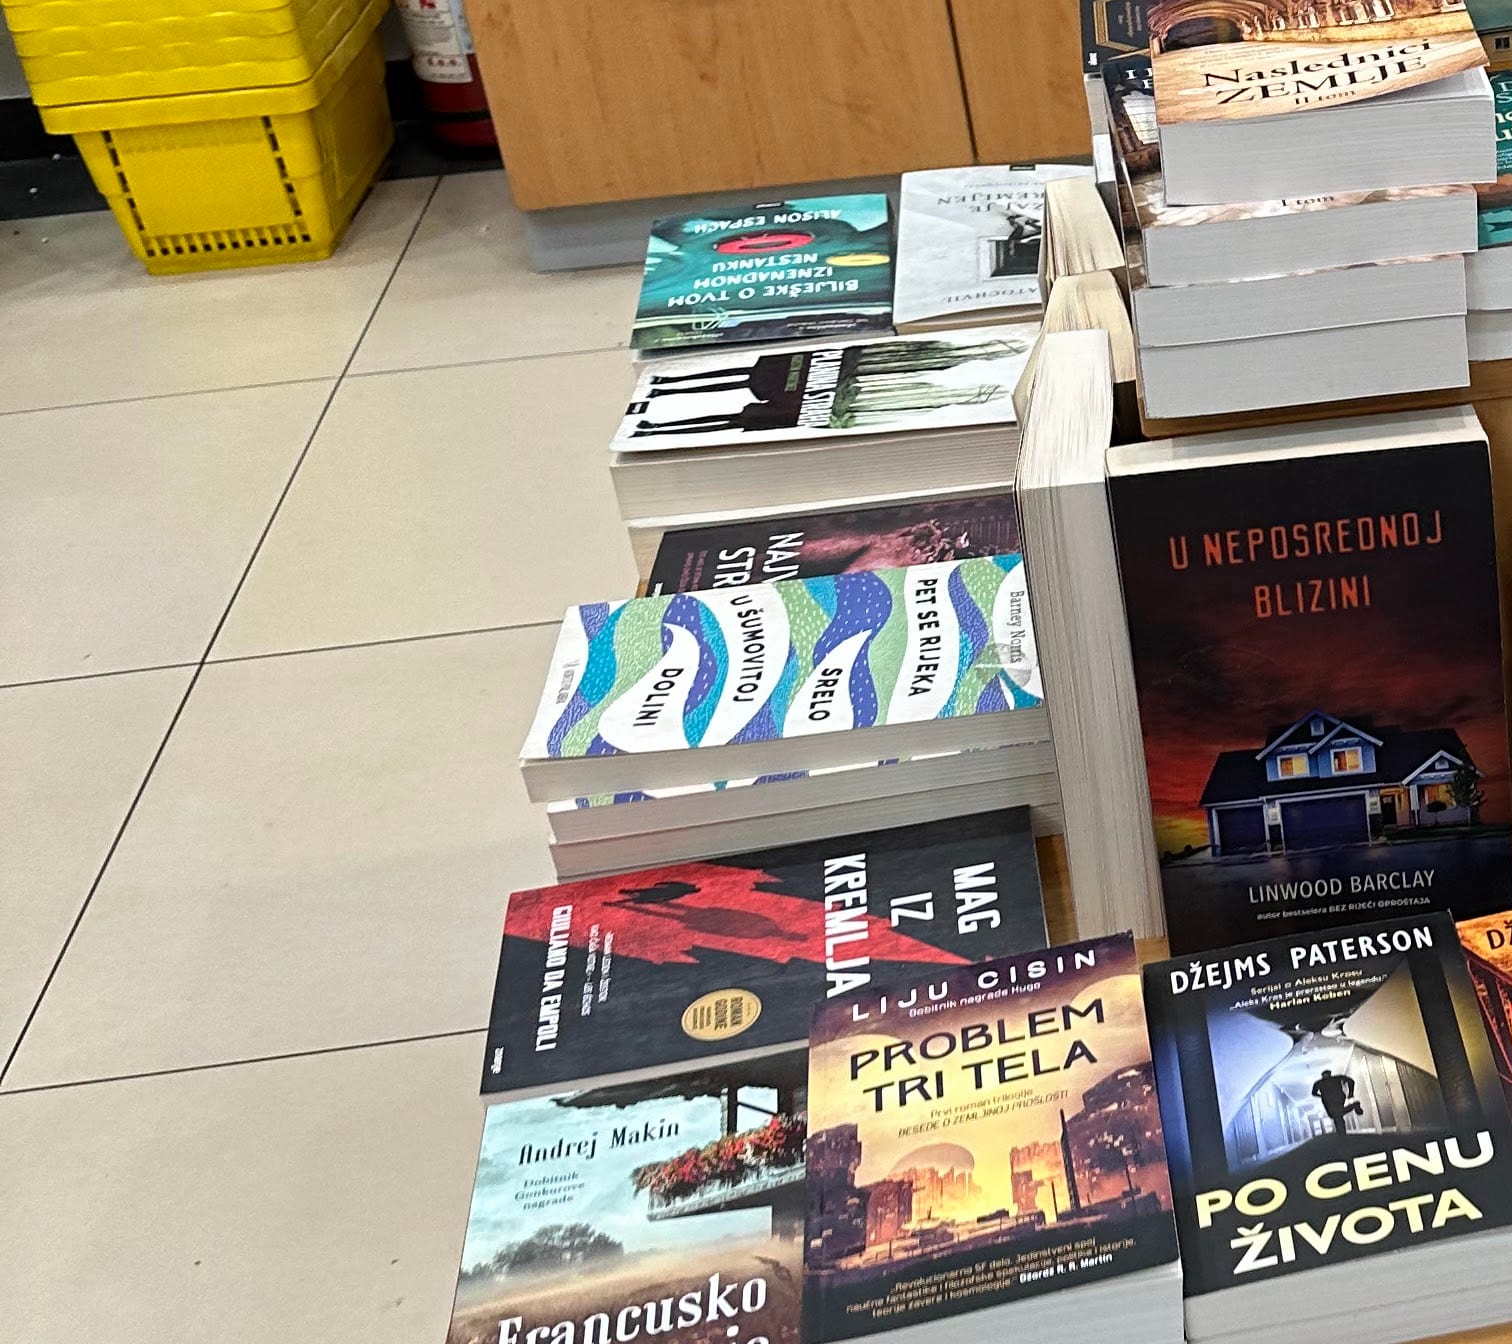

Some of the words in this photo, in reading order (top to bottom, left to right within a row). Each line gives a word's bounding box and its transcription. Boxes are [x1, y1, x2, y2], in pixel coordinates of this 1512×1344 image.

[1203, 39, 1433, 87] Naslednici
[1217, 56, 1428, 105] ZEMLJE
[693, 266, 835, 289] IZNENADNOM
[711, 252, 819, 271] NESTANKU
[667, 285, 727, 307] TVOM
[762, 279, 860, 299] BILJEŠKE
[1168, 536, 1190, 570] U
[1203, 511, 1444, 568] NEPOSREDNOJ
[728, 595, 741, 607] U
[913, 578, 939, 606] PET
[1007, 590, 1025, 627] Barney
[1254, 575, 1372, 619] BLIZINI
[914, 606, 937, 632] SE
[731, 608, 766, 704] ŠUMOVITOJ
[907, 632, 939, 698] RIJEKA
[632, 666, 685, 727] DOLINI
[808, 667, 843, 721] SRELO
[889, 891, 935, 927] IZ
[951, 861, 1001, 935] MAG
[1248, 876, 1343, 905] LINWOOD
[1349, 869, 1436, 895] BARCLAY
[545, 904, 573, 968] GIULIANO
[823, 852, 874, 999] KREMLJA
[542, 968, 566, 993] DA
[1170, 952, 1271, 995] DŽEJMS
[1290, 926, 1434, 970] PATERSON
[851, 980, 949, 1023] LIJU
[976, 949, 1098, 990] CISIN
[535, 993, 562, 1052] EMPOLI
[849, 998, 1105, 1080] PROBLEM
[862, 1072, 943, 1114] TRI
[961, 1039, 1098, 1091] TELA
[518, 1131, 599, 1167] Andrej
[608, 1118, 681, 1150] Makin
[522, 1193, 574, 1211] nagrade
[523, 1170, 580, 1189] Dobitnik
[1195, 1178, 1289, 1229] PO
[1304, 1131, 1496, 1200] CENU
[1230, 1187, 1483, 1275] ŽIVOTA
